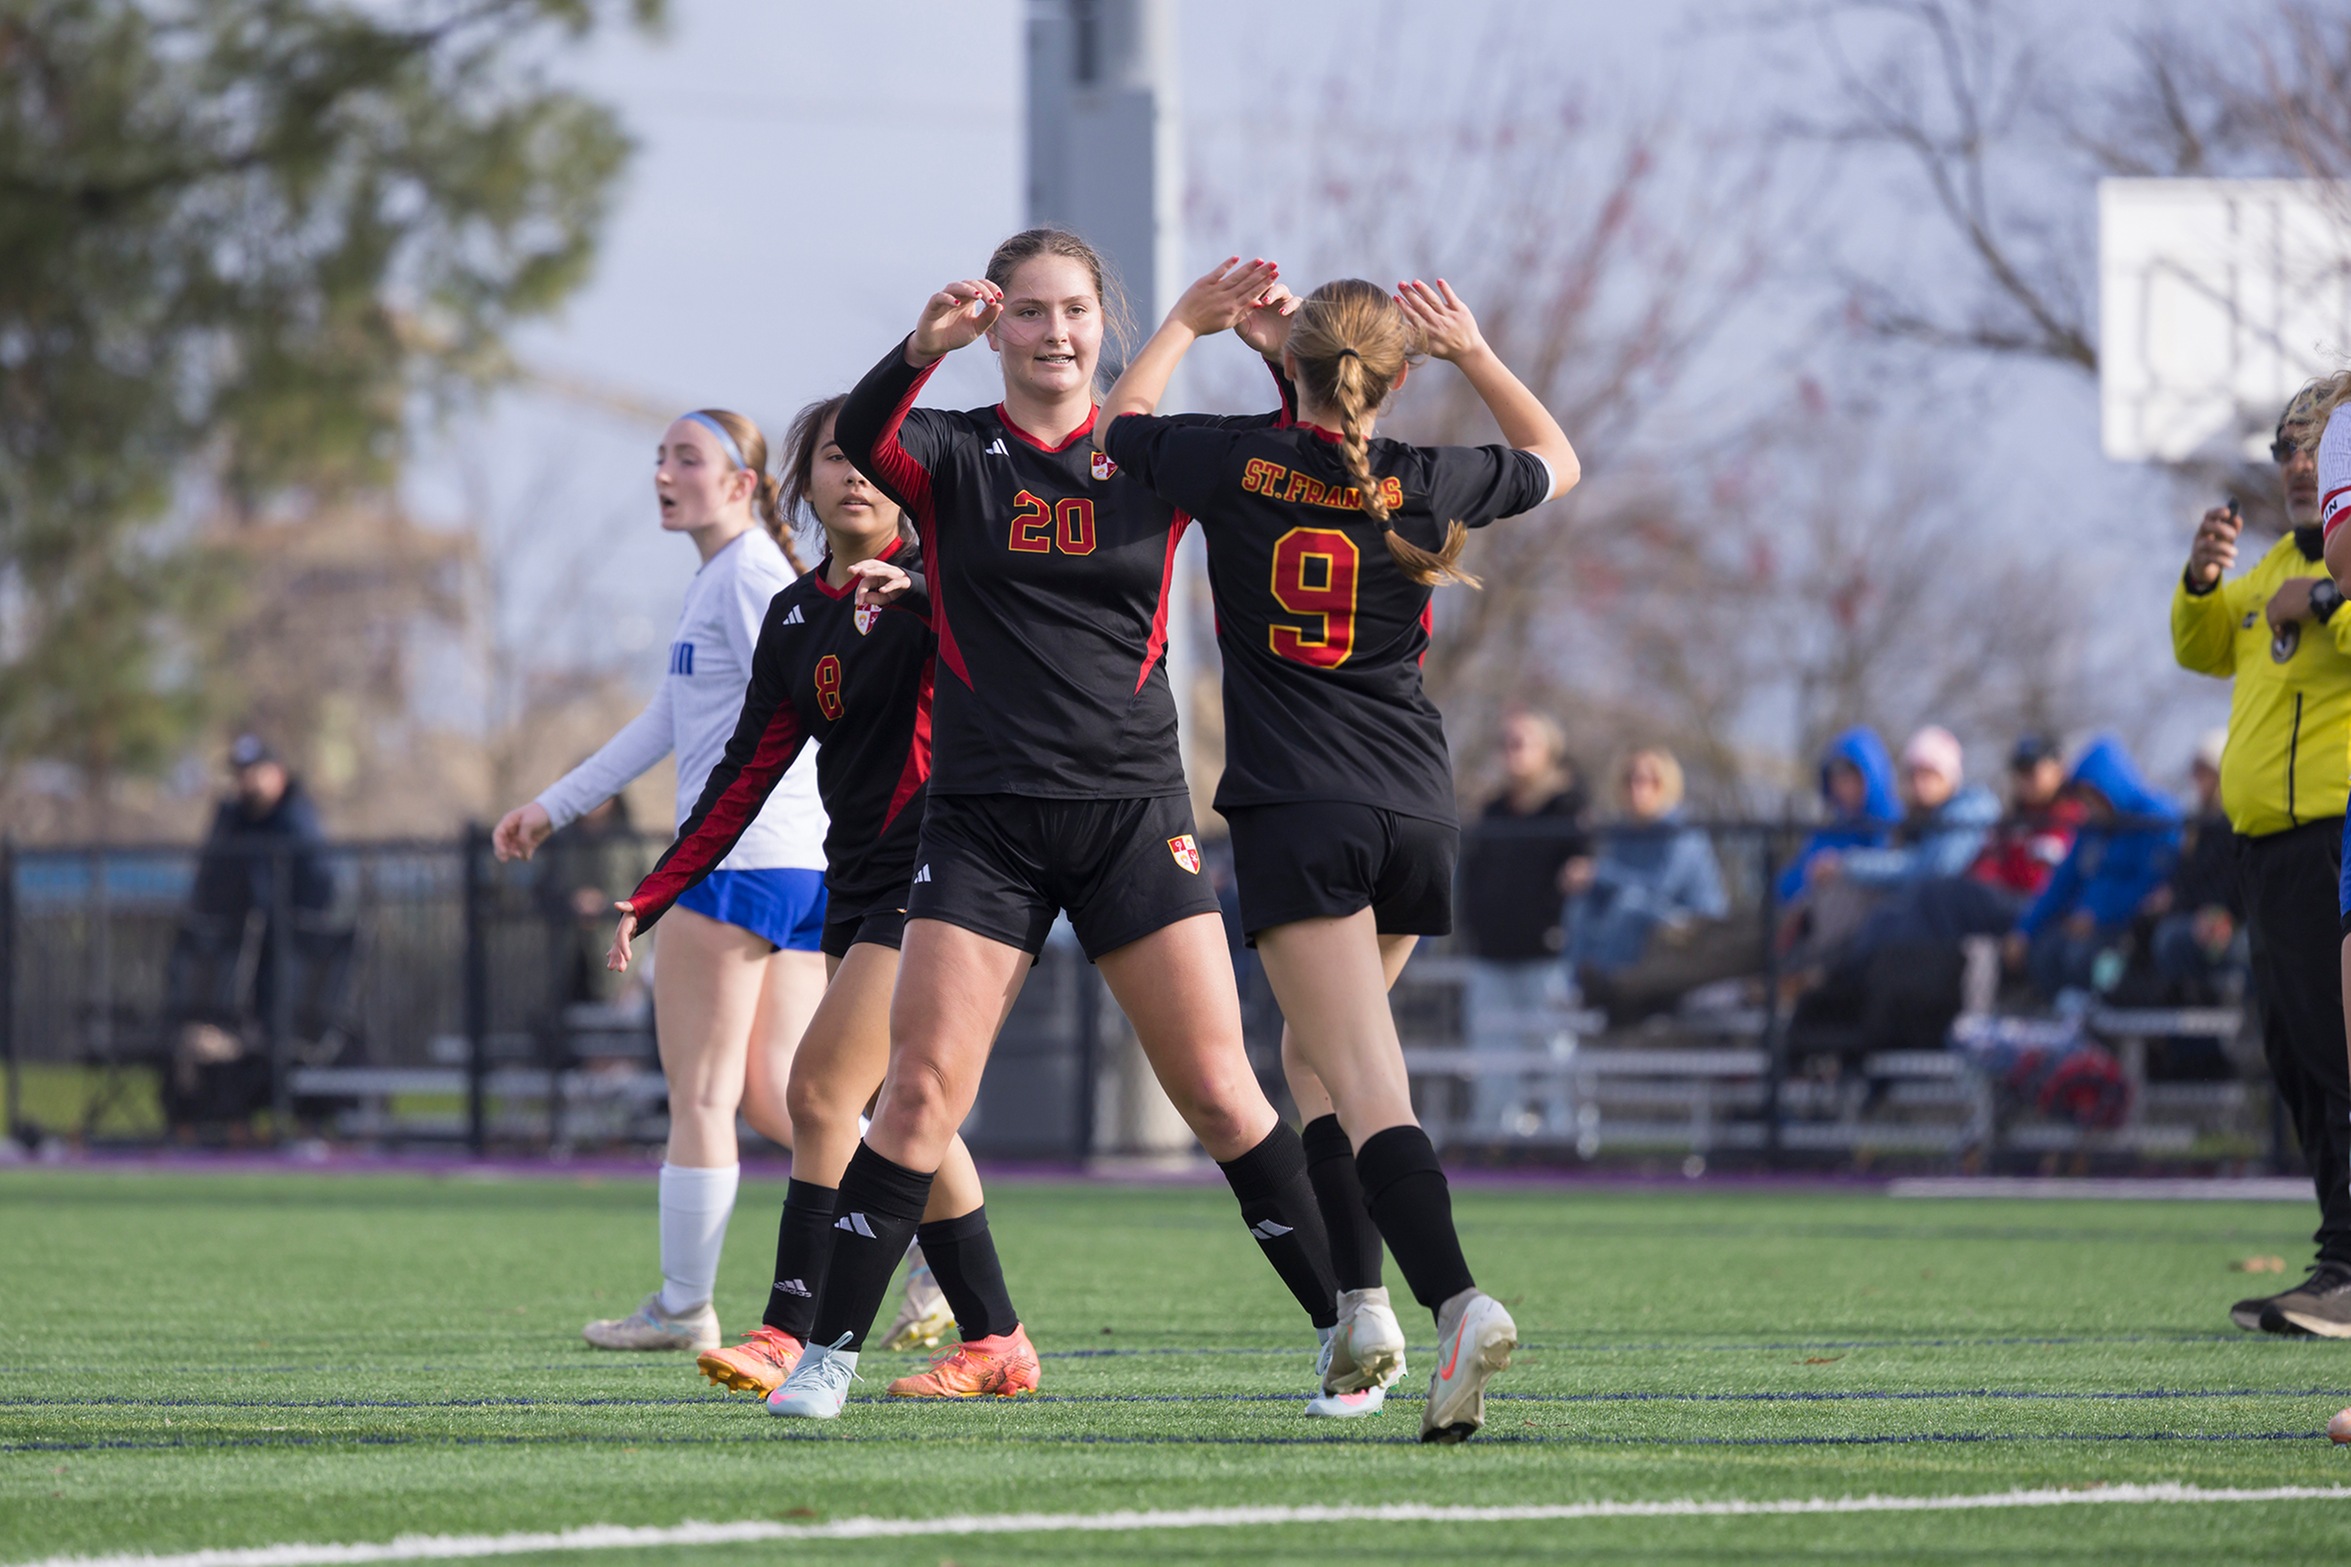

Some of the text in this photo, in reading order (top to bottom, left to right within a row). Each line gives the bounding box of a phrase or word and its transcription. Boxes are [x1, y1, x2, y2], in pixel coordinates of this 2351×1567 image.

[1241, 458, 1403, 510] ST.FRANS
[1008, 489, 1097, 556] 20
[1269, 526, 1359, 670] 9
[815, 654, 844, 721] 8
